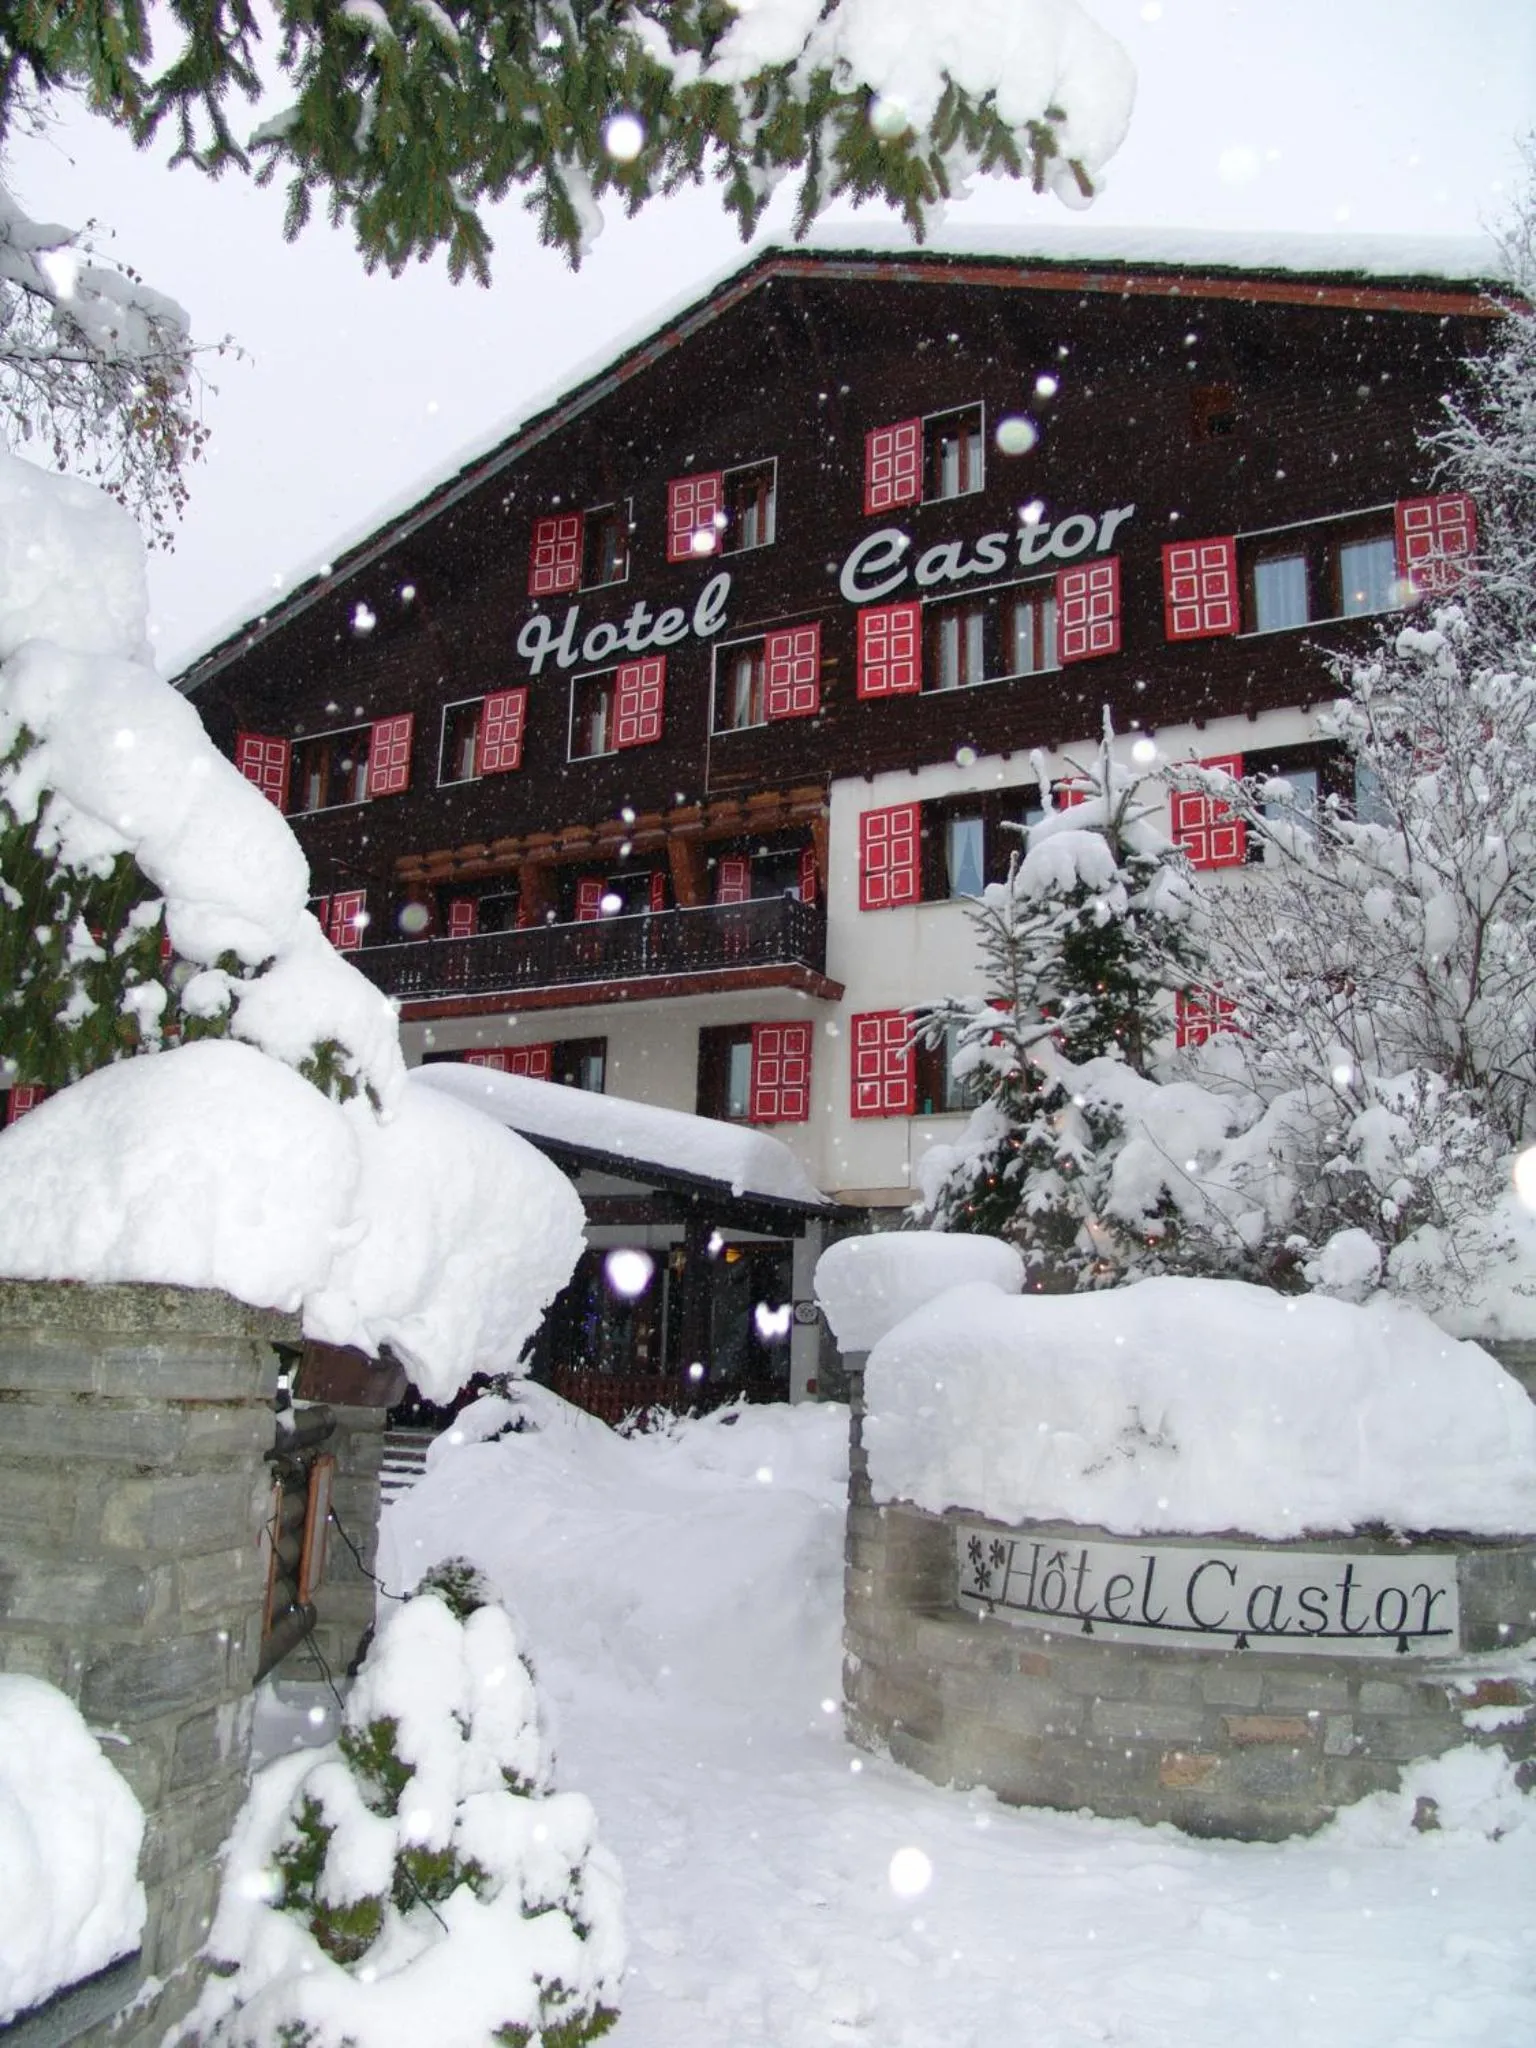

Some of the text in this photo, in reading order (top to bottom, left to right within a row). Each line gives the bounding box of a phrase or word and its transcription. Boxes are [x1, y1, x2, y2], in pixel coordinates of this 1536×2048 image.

[517, 504, 1136, 676] Hotel Castor
[1001, 1540, 1446, 1633] Hôtel Castor
